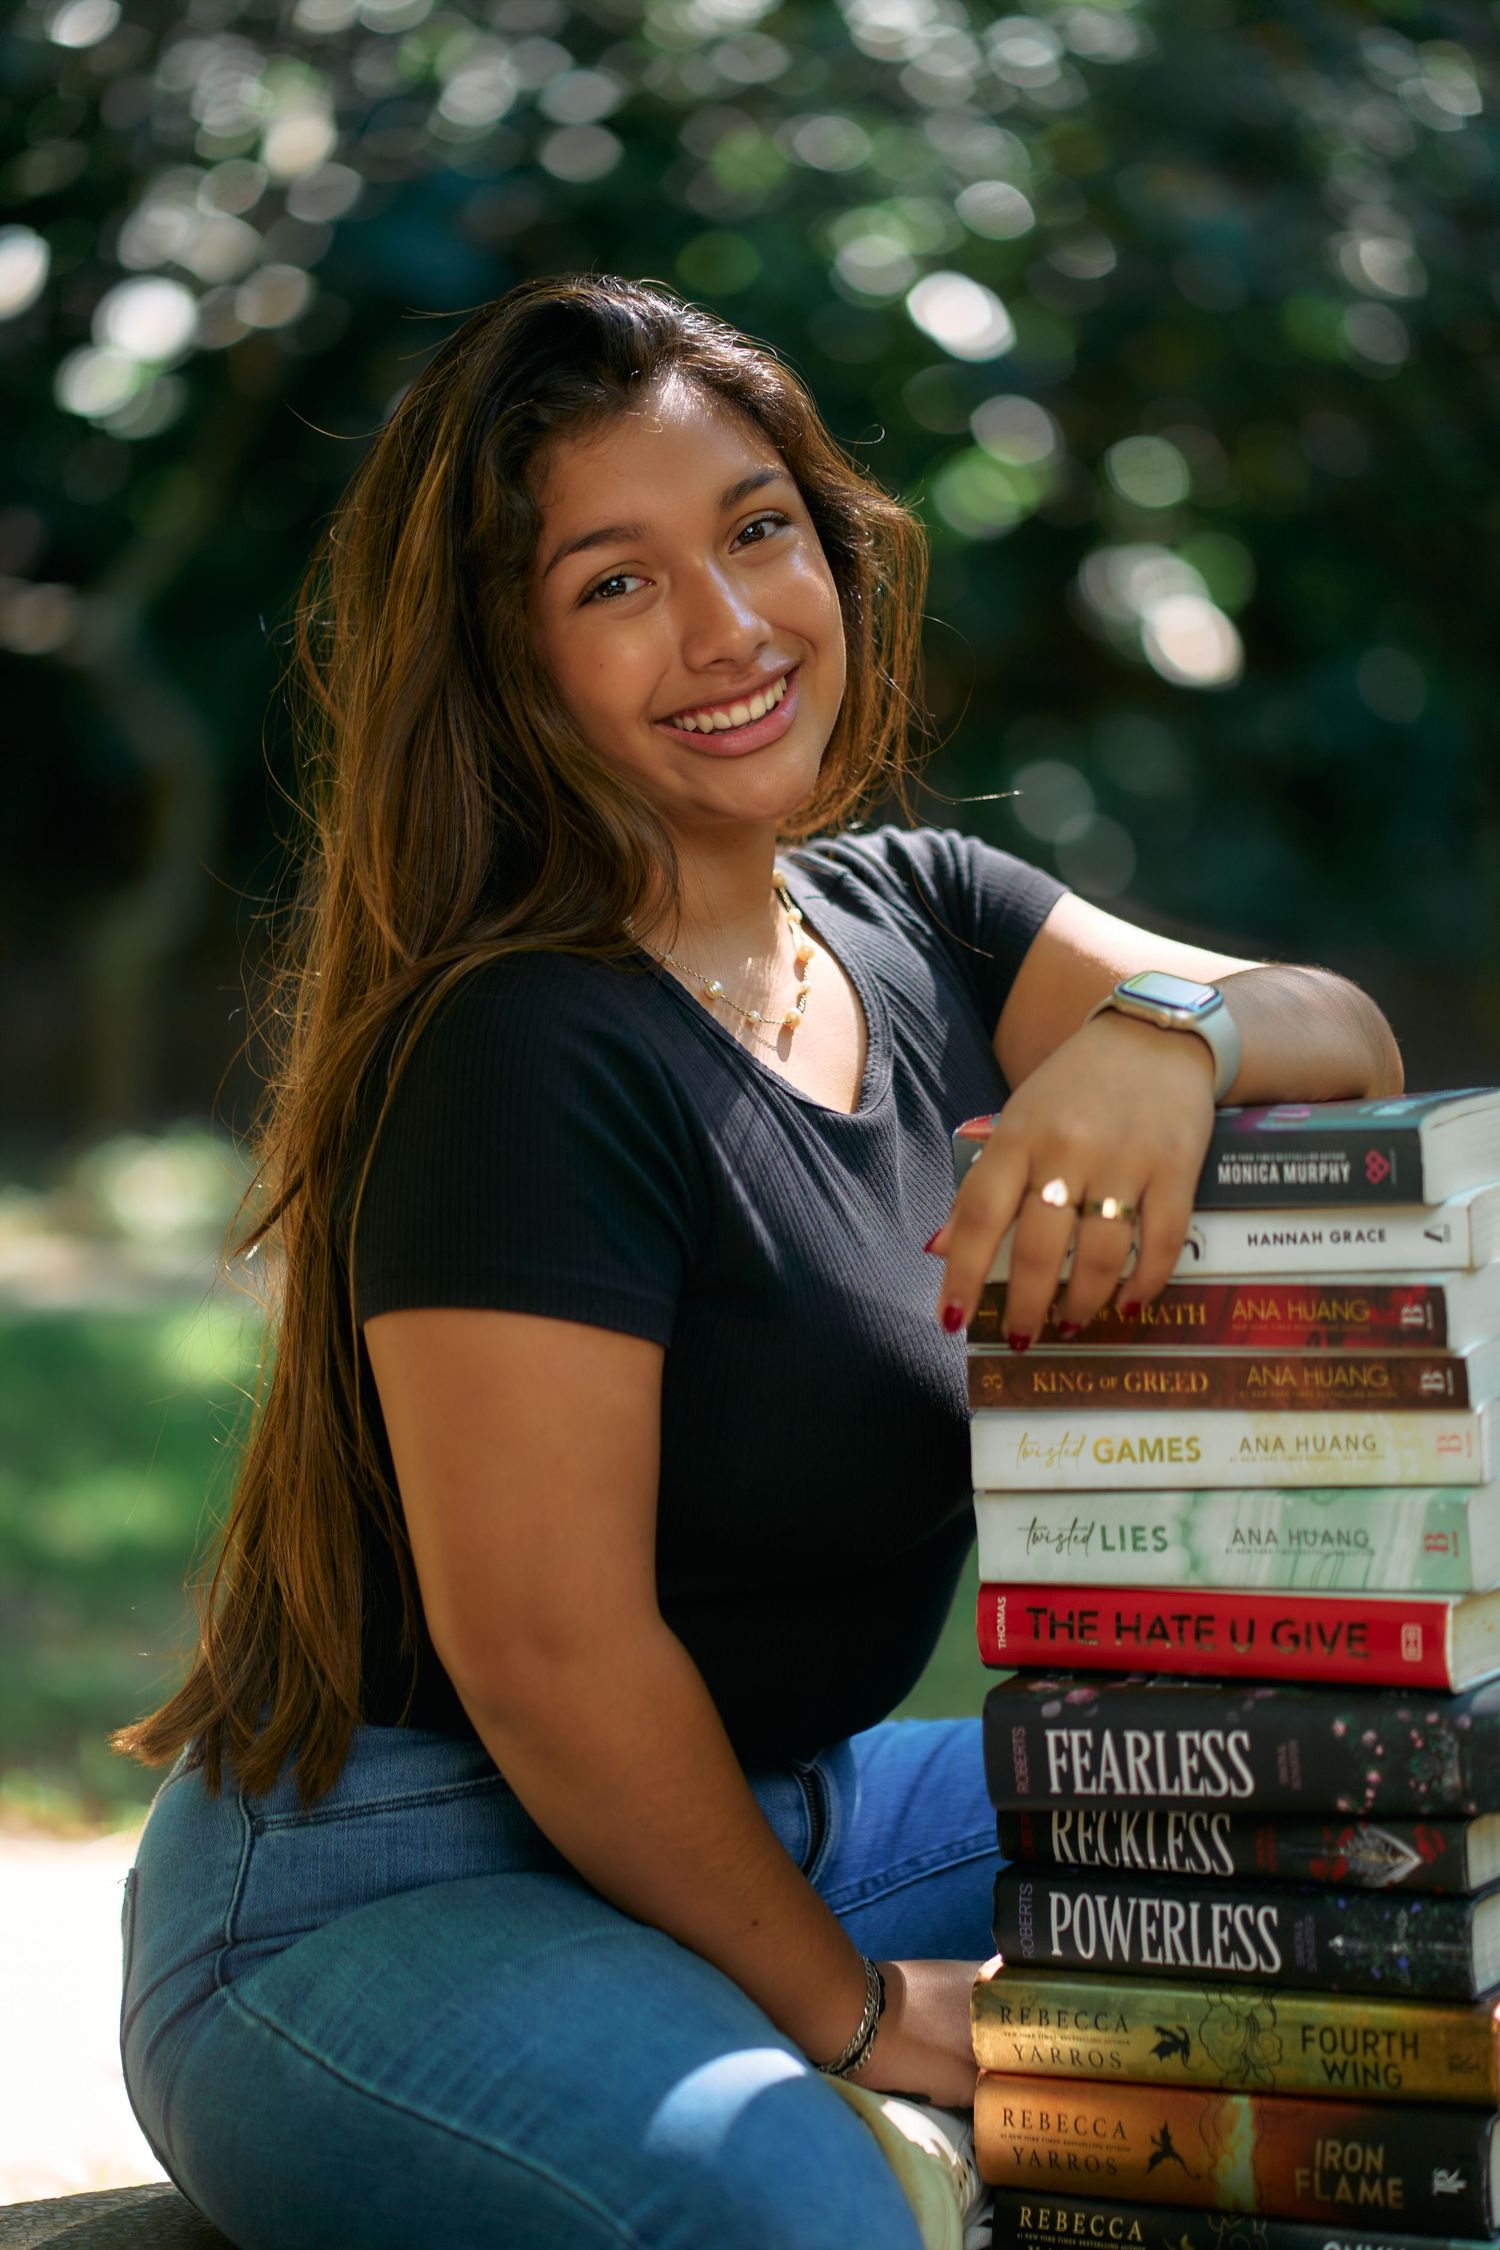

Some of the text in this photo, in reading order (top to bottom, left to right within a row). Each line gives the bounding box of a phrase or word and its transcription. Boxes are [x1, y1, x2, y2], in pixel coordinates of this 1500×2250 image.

[1218, 1162, 1351, 1185] MONICA MURPHY
[1247, 1229, 1387, 1246] HANNAH GRACE
[1232, 1299, 1371, 1322] ANA HUANG
[1032, 1371, 1094, 1393] KING
[1123, 1371, 1210, 1393] GREED
[1246, 1364, 1389, 1388] ANA HUANG
[1008, 1431, 1202, 1469] twisted GAMES
[1239, 1434, 1377, 1453] ANA HUANG
[1017, 1516, 1168, 1557] twisted LIES
[1232, 1528, 1370, 1548] ANA HUANG
[996, 1595, 1007, 1650] THOMAS
[1025, 1607, 1099, 1645] THE
[1115, 1611, 1216, 1651] HATE
[1230, 1617, 1255, 1653] U
[1270, 1618, 1370, 1658] GIVE
[1012, 1725, 1030, 1794] ROBERTS
[1045, 1728, 1255, 1798] FEARLESS
[1051, 1810, 1236, 1877] RECKLESS
[1018, 1881, 1035, 1960] ROBERTS
[1049, 1891, 1283, 1974] POWERLESS
[1000, 2005, 1129, 2033] REBECCA
[1012, 2043, 1122, 2070] YARROS
[1301, 2025, 1419, 2061] FOURTH
[1321, 2057, 1403, 2090] WING
[1002, 2107, 1127, 2140] REBECCA
[1012, 2146, 1118, 2176] YARROS
[1314, 2138, 1385, 2175] IRON
[1295, 2167, 1404, 2209] FLAME
[1019, 2205, 1144, 2242] REBECCA
